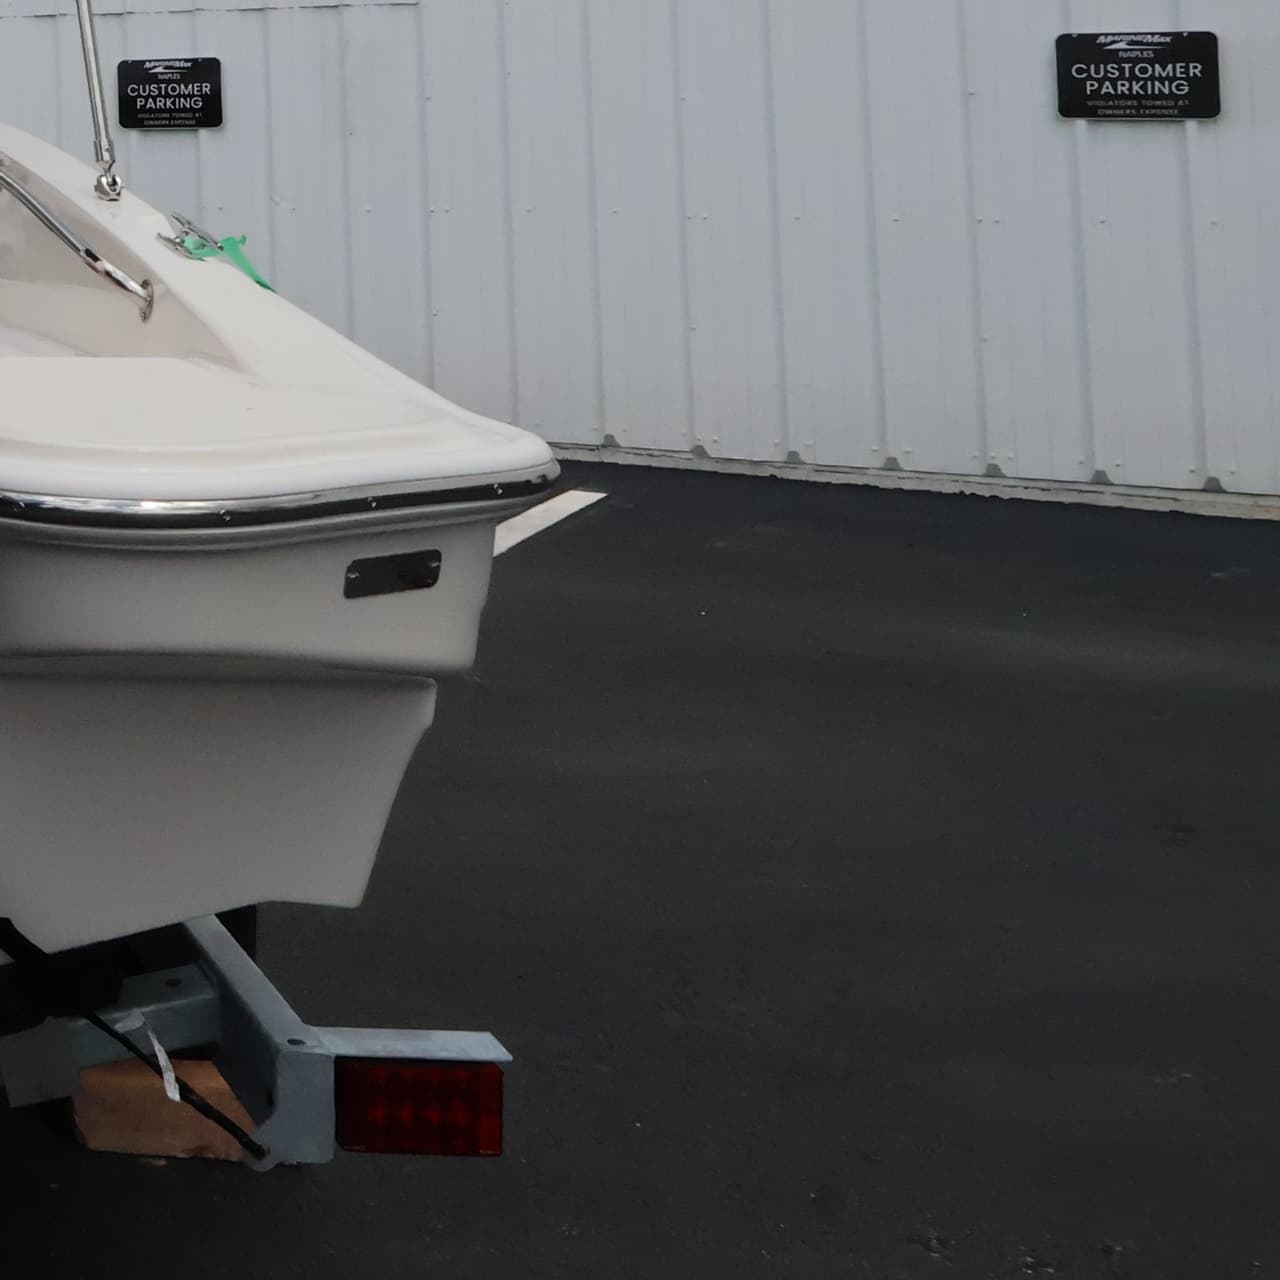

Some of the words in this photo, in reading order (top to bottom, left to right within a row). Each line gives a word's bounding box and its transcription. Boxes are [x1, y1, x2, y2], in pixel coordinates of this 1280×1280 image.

[1071, 63, 1203, 79] CUSTOMER
[127, 82, 211, 97] CUSTOMER
[1086, 80, 1191, 96] PARKING
[136, 96, 203, 110] PARKING
